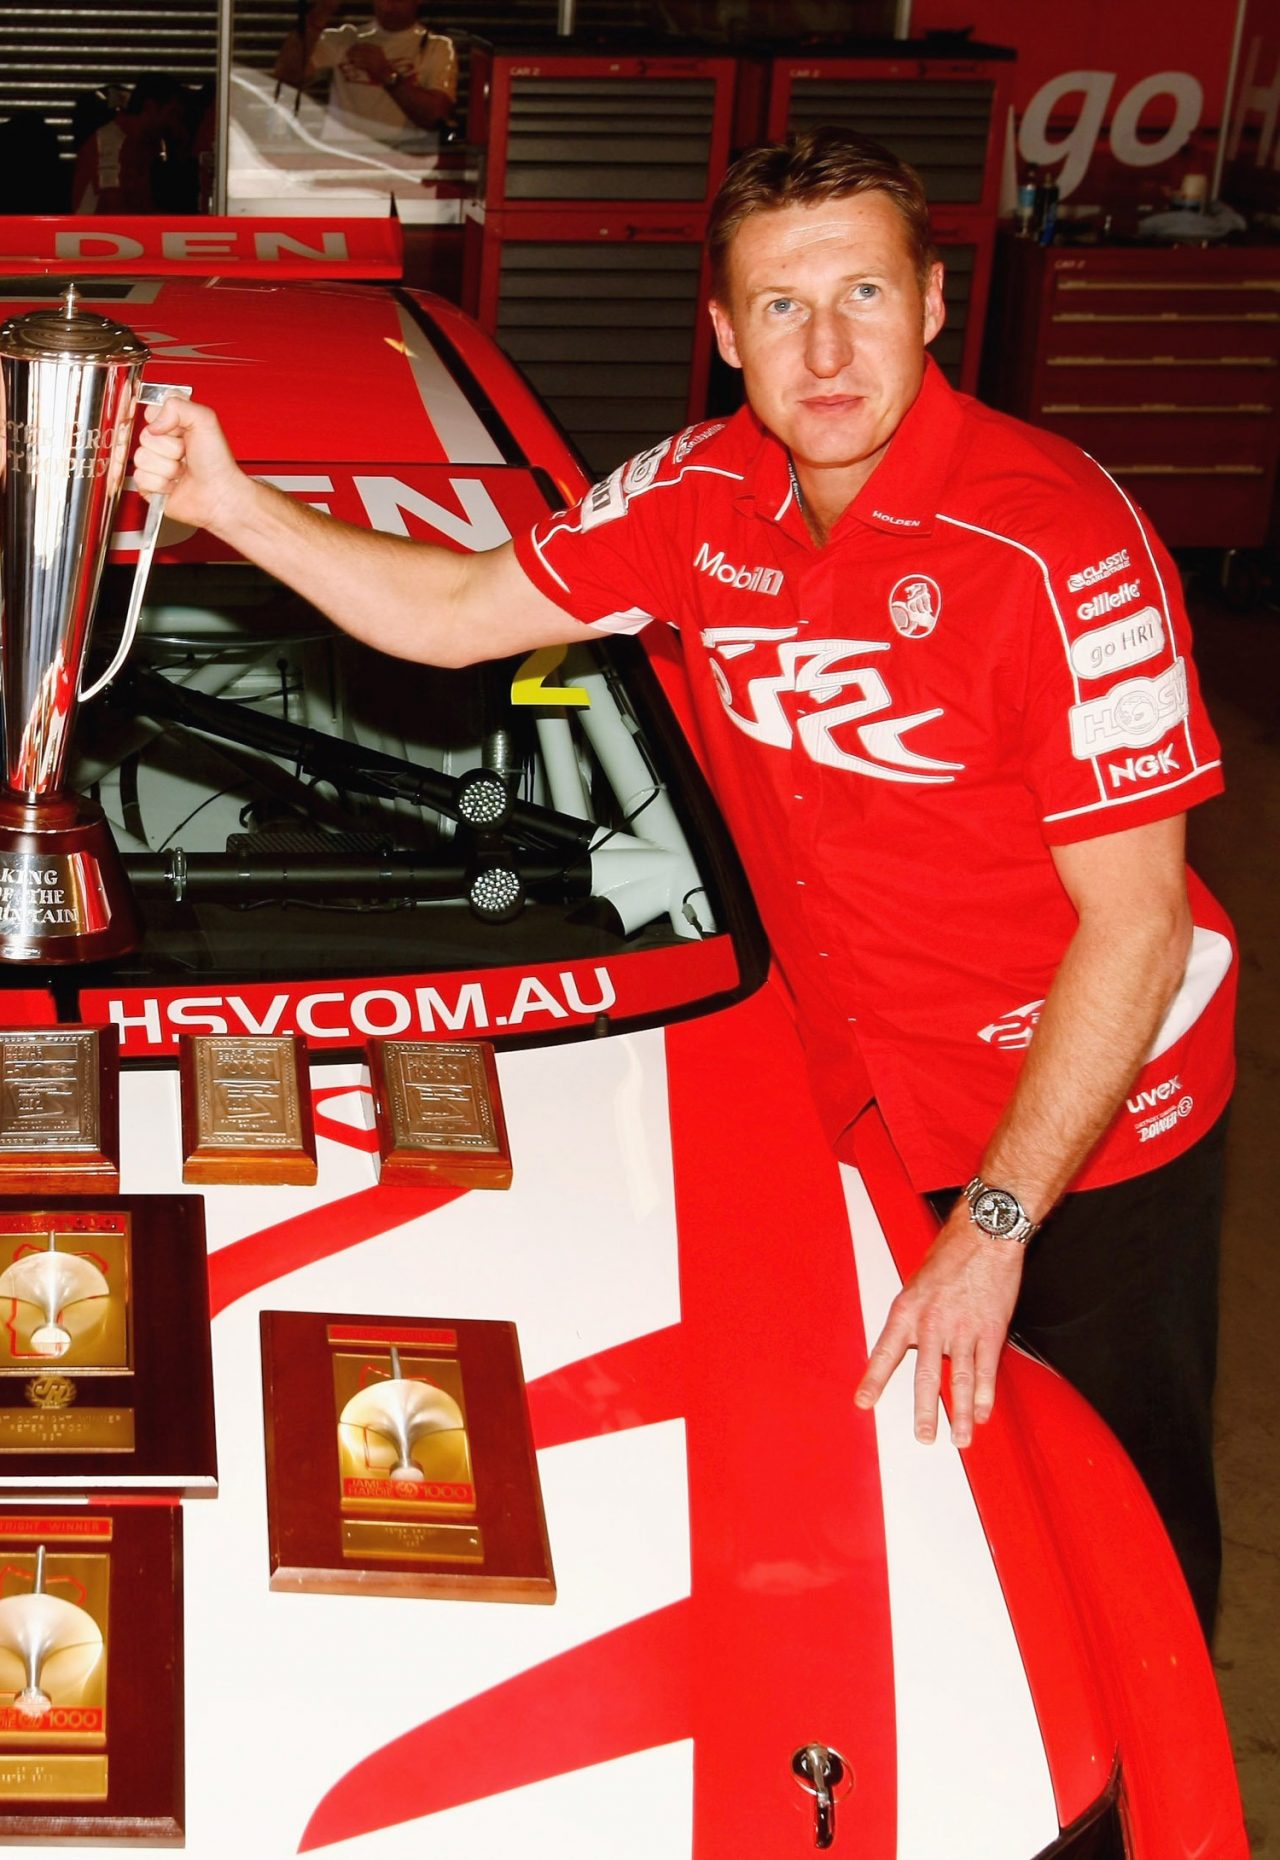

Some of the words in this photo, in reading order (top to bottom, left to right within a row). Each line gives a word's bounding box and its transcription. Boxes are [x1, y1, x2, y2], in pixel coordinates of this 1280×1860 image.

[1018, 70, 1204, 201] go
[872, 510, 921, 527] HOLDEN
[1083, 549, 1130, 580] CLASSIC
[1077, 582, 1140, 620] Gillette
[1091, 643, 1116, 669] go
[1108, 743, 1181, 788] NGK
[0, 867, 59, 886] KING
[28, 889, 65, 905] THE
[1126, 1075, 1183, 1113] uvex
[422, 1483, 469, 1499] 1000
[49, 1521, 100, 1533] WINNER
[49, 1710, 98, 1729] 1000
